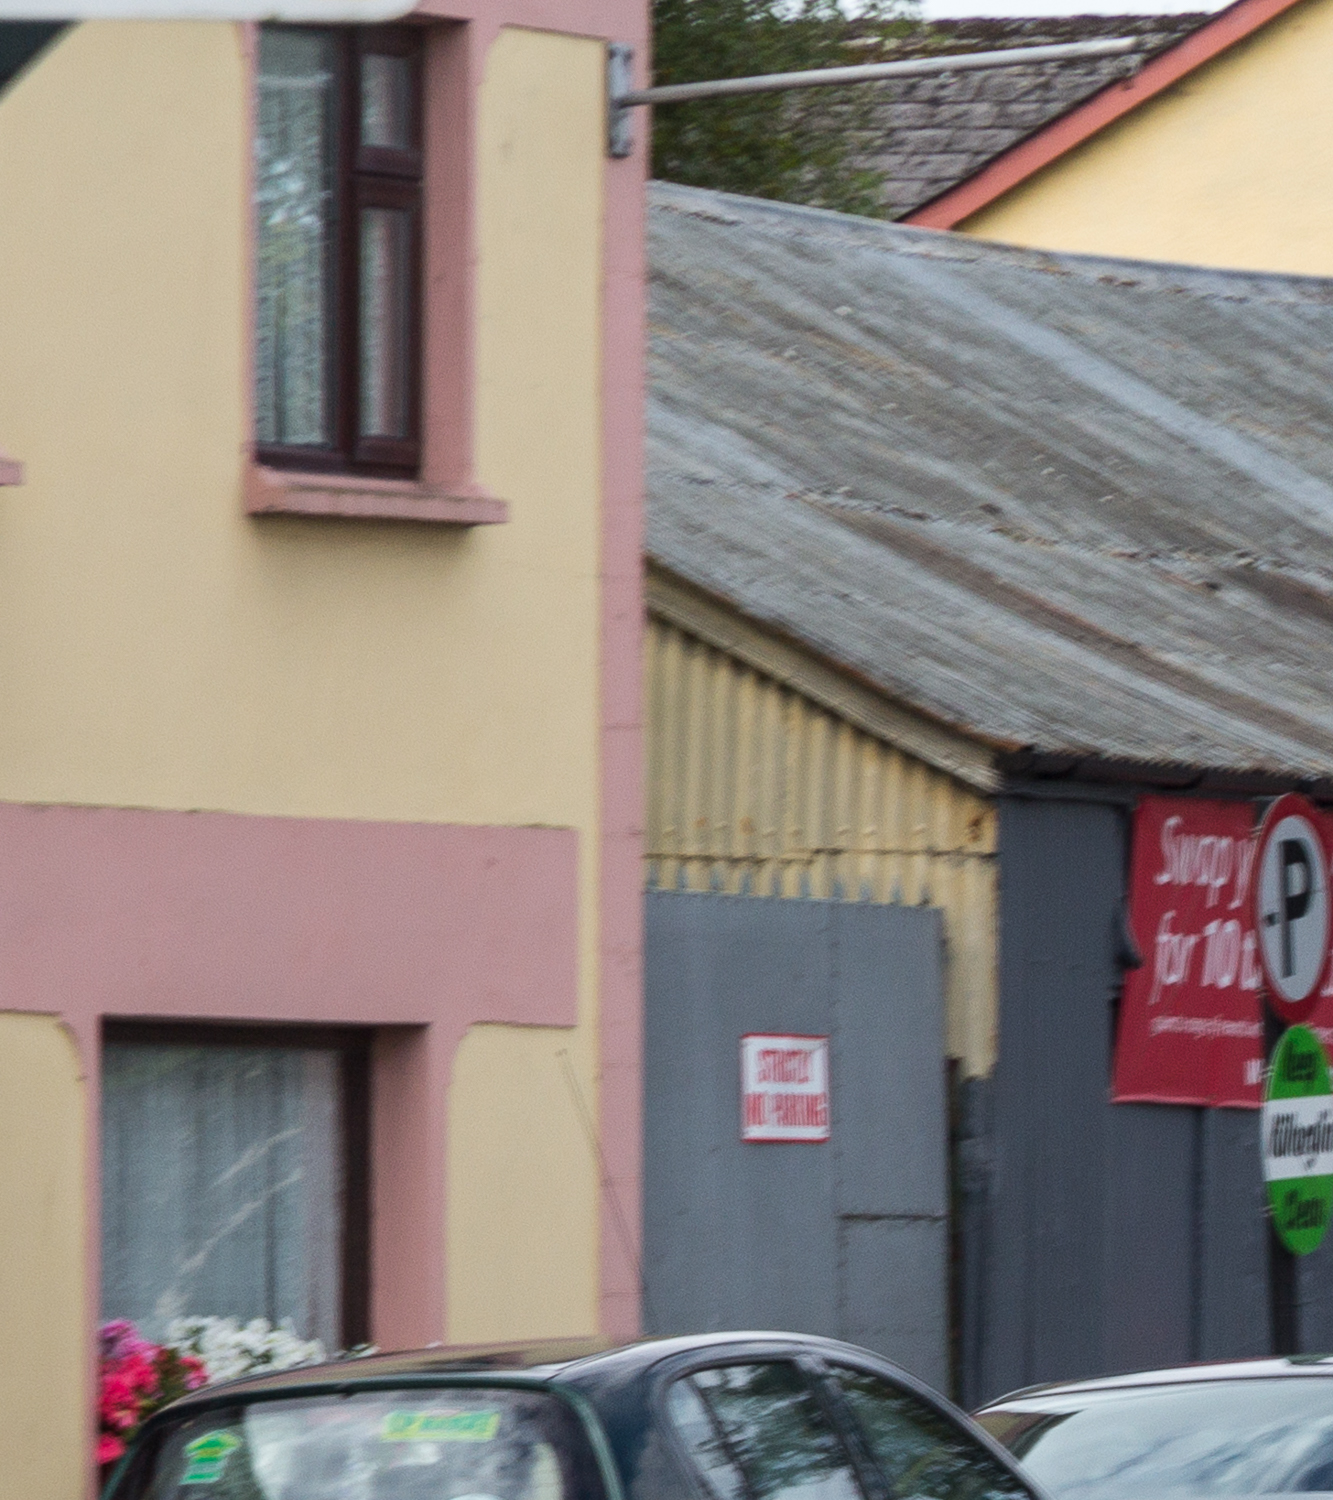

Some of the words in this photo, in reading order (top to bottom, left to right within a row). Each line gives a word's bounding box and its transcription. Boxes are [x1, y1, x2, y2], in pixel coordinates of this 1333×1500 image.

[1153, 814, 1233, 907] Swap
[1148, 909, 1197, 1004] for
[1201, 918, 1241, 990] 10
